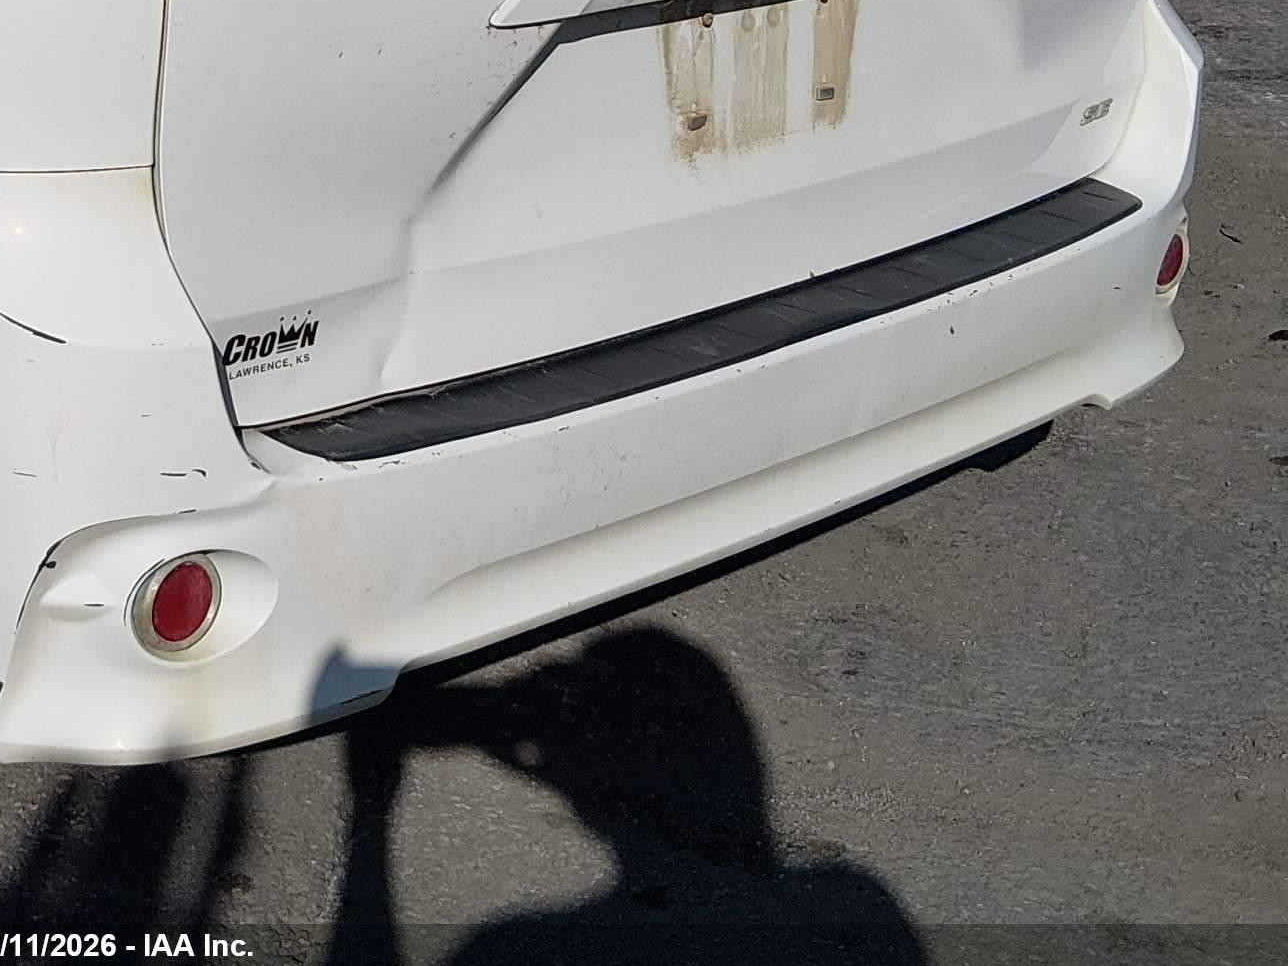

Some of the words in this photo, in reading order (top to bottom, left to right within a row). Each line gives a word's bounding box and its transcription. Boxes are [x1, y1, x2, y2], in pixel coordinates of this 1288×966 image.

[222, 310, 319, 366] CROWN
[229, 358, 293, 380] LAWRENCE,
[296, 353, 311, 364] KS
